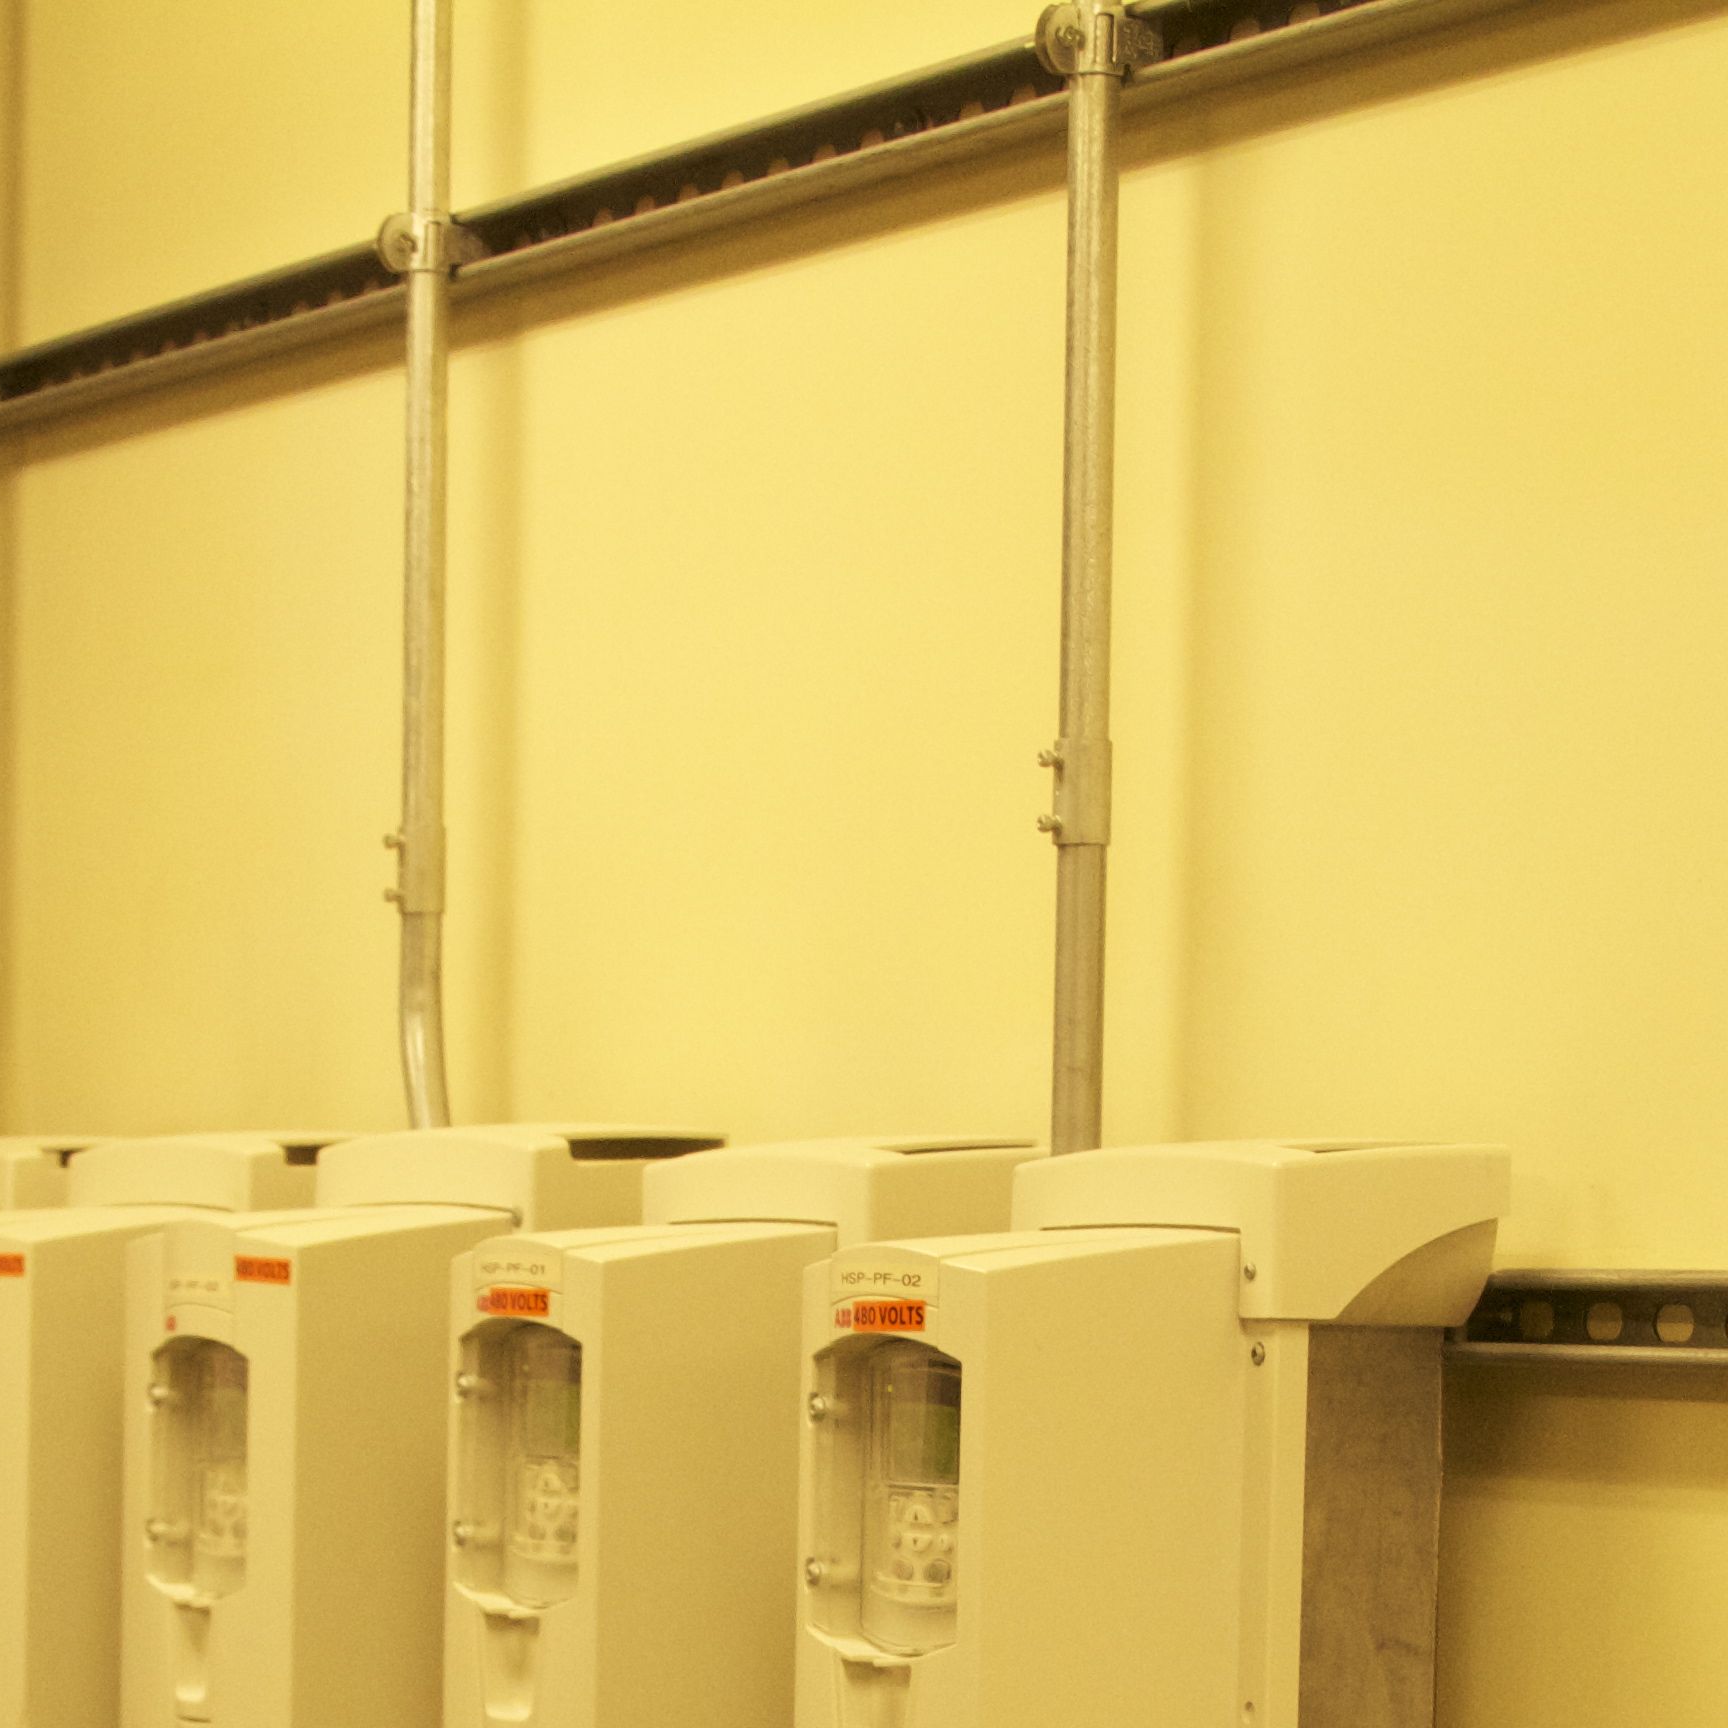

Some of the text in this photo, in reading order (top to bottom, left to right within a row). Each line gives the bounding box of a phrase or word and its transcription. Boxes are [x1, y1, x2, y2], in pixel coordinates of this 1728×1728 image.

[841, 1271, 922, 1288] HSP-PF-02
[511, 1293, 549, 1313] VOLTS
[853, 1305, 925, 1326] 480 VOLTS
